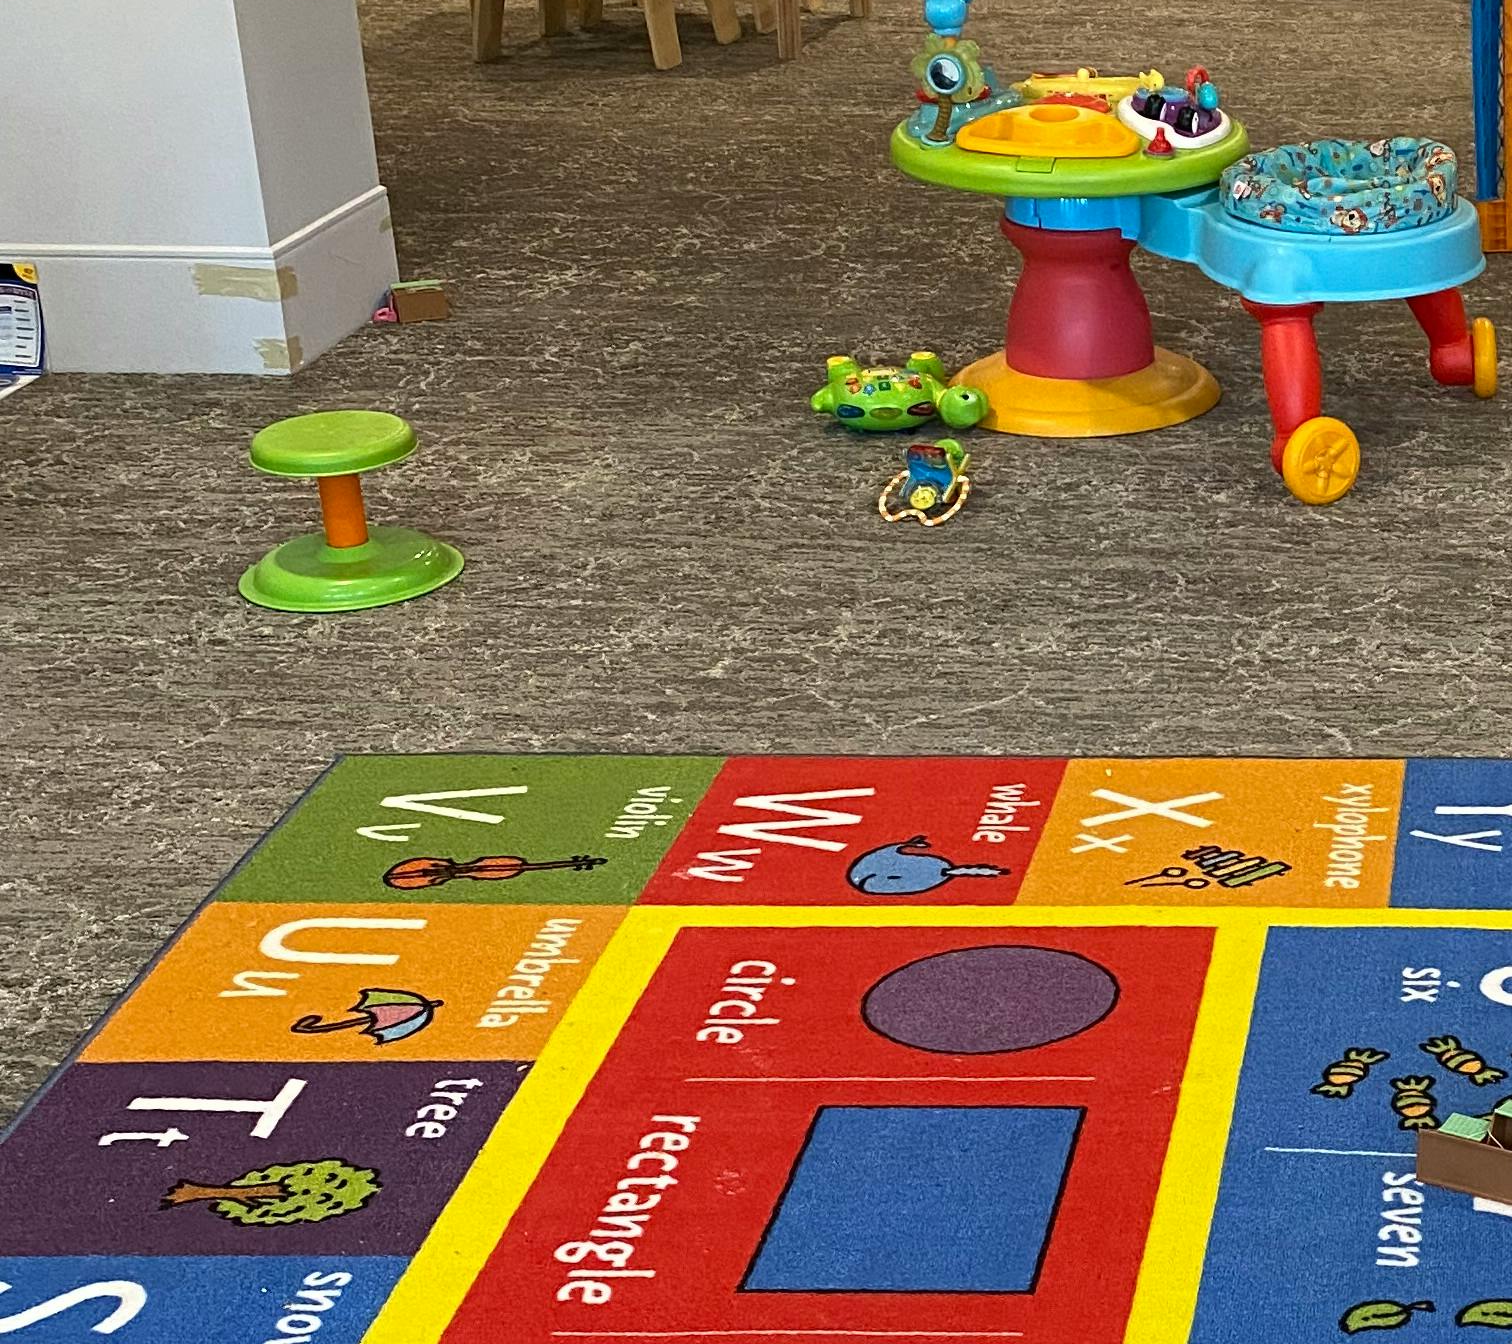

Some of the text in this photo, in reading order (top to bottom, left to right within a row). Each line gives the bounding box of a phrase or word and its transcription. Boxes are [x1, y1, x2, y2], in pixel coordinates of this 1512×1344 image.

[605, 787, 673, 838] violin
[973, 784, 1040, 842] whale
[1313, 784, 1373, 888] xylophone
[477, 919, 581, 1027] umbrella
[697, 961, 795, 1043] circle
[1401, 968, 1460, 1002] six
[406, 1079, 483, 1138] tree
[555, 1116, 700, 1303] rectangle
[1376, 1172, 1424, 1267] seven
